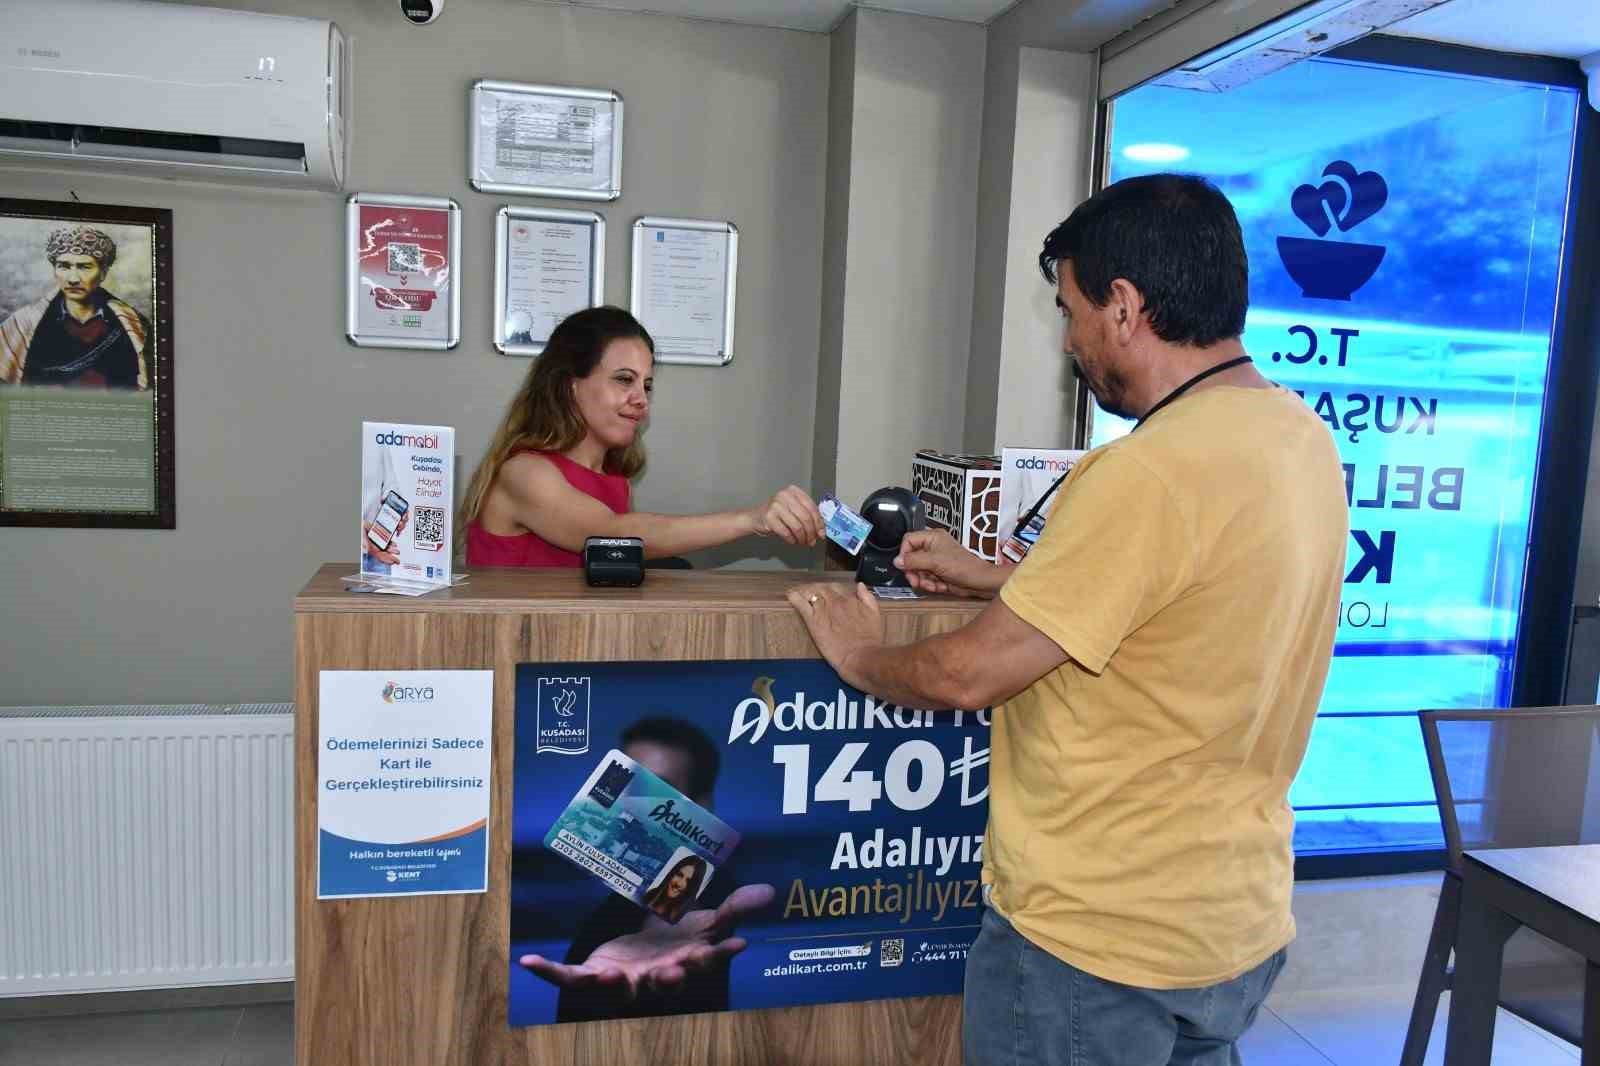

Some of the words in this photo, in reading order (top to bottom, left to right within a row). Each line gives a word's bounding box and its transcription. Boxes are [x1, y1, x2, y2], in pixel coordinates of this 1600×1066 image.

[375, 430, 438, 449] adamobil
[326, 737, 428, 751] Ödemelerinizi
[431, 737, 485, 750] Sadece
[380, 757, 411, 769] Kart
[415, 756, 432, 769] ile
[325, 777, 484, 792] Gerçekleştirebilirsiniz
[783, 869, 979, 924] Avantajlıyız
[763, 961, 868, 977] adalikart.com.tr
